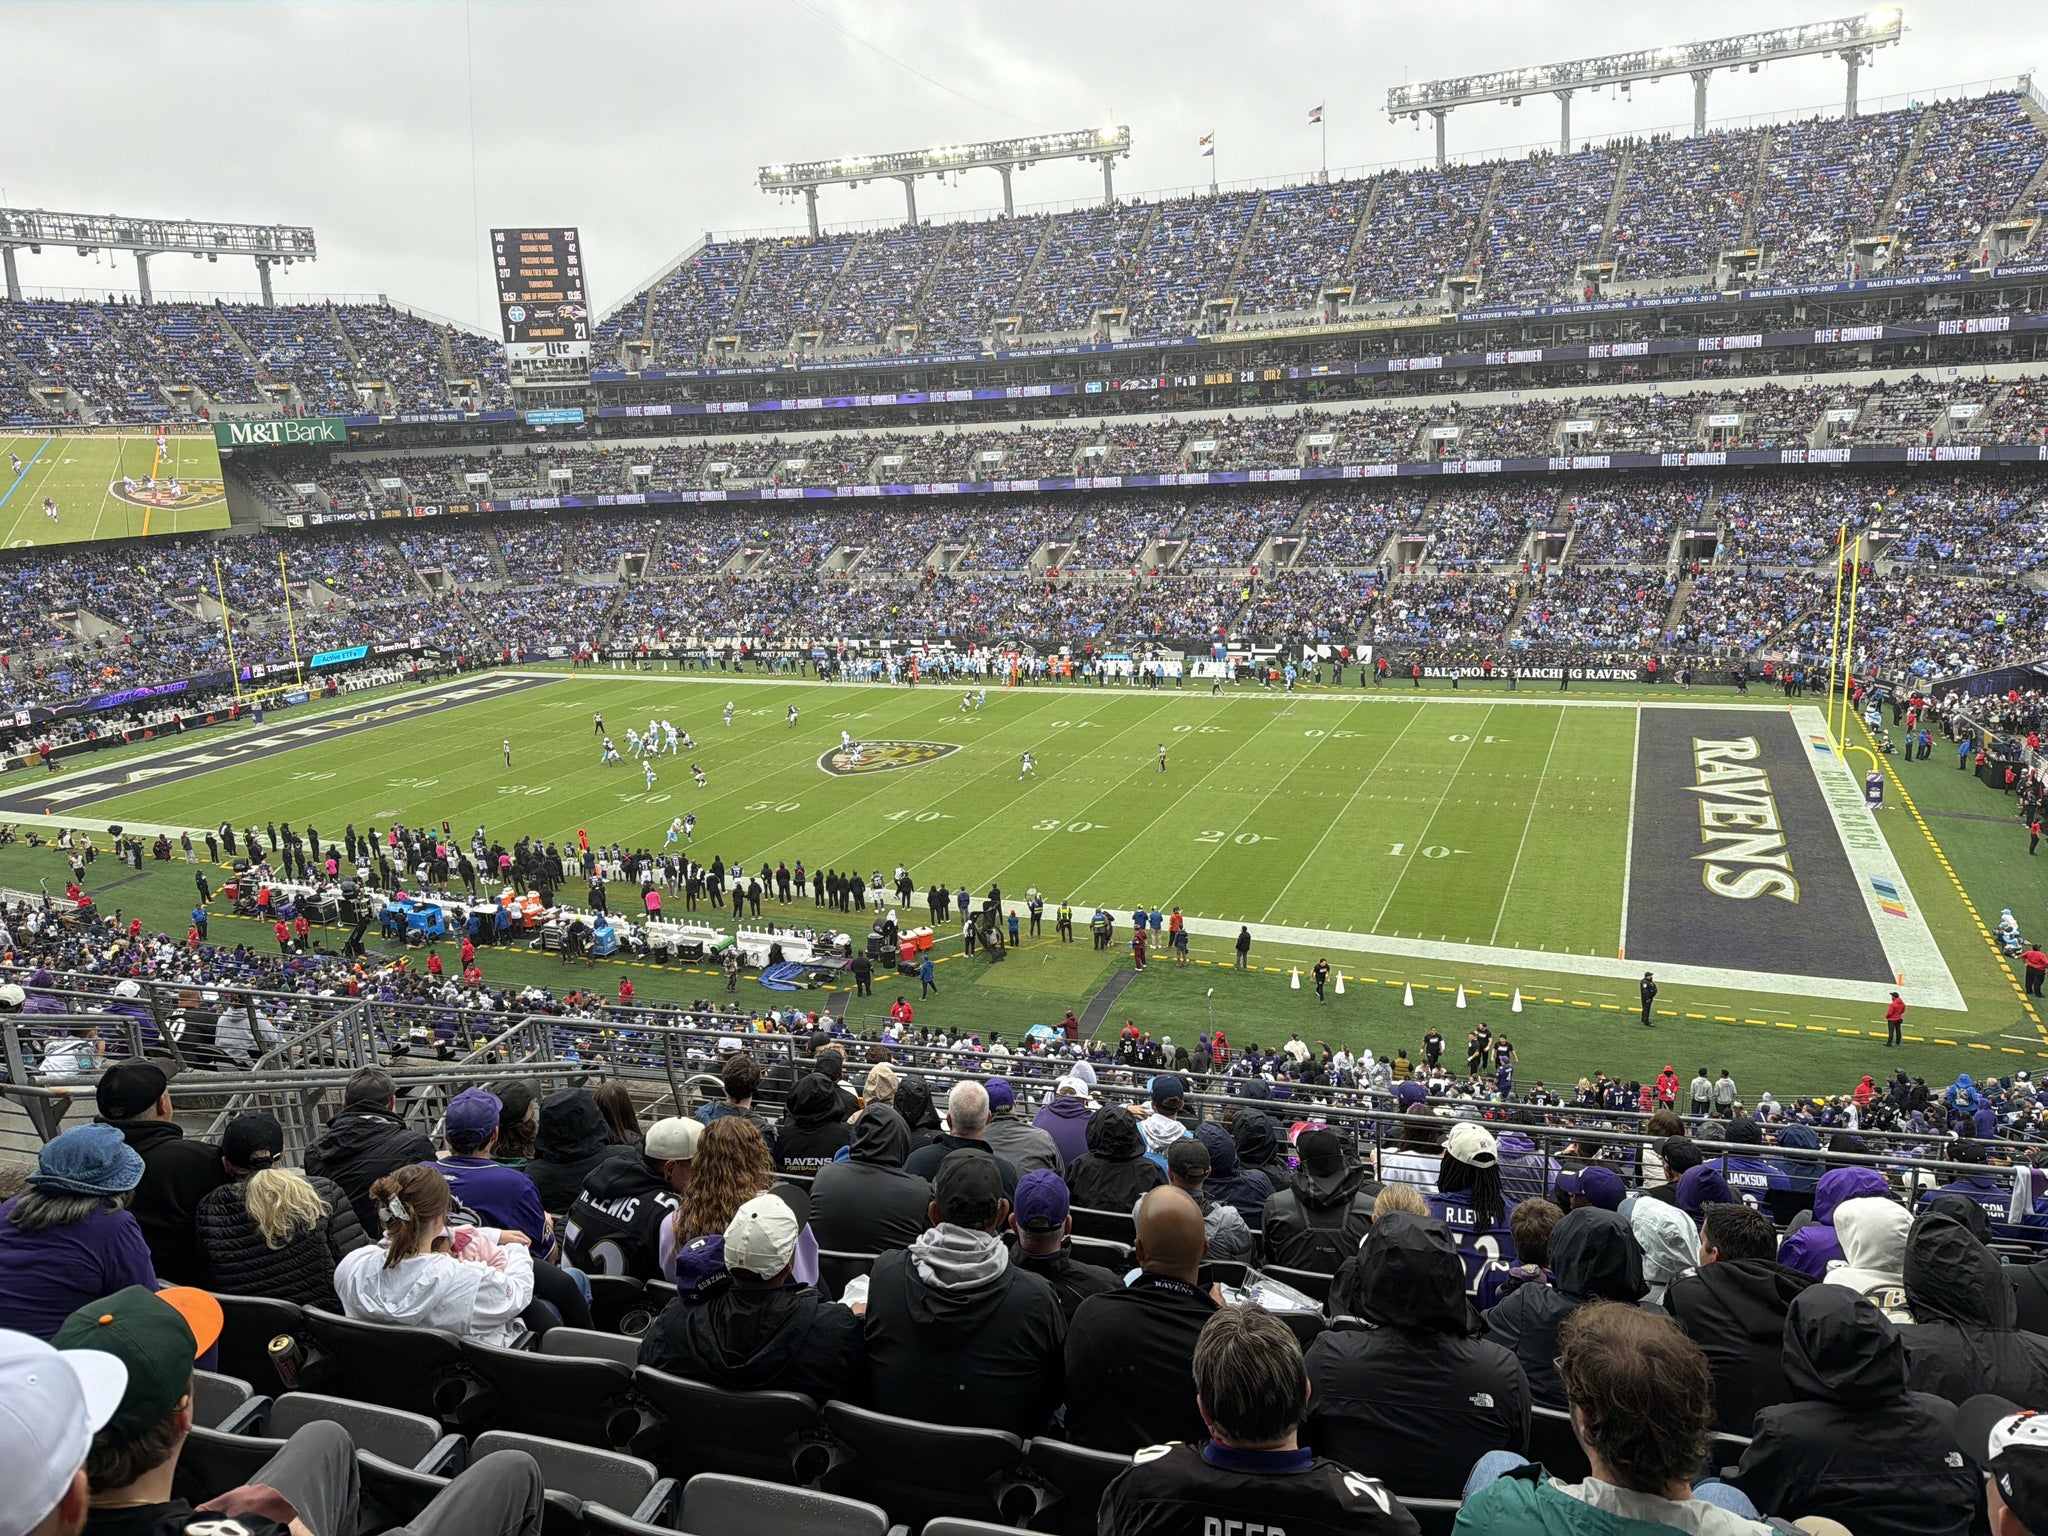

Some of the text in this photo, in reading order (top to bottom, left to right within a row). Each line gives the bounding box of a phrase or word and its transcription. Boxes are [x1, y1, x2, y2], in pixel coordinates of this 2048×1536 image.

[563, 231, 575, 241] 227
[496, 244, 504, 254] 47
[568, 243, 577, 253] 42
[1997, 267, 2017, 275] RING
[1866, 273, 1962, 288] HALOTI NGATA 2006-2014
[1750, 284, 1838, 298] BRIAN BILLICK 1999-2007
[1643, 294, 1717, 307] TODD HEAP 2001-2010
[1462, 309, 1536, 321] MATT STOVER 1996-2008
[1552, 302, 1628, 315] JAMAL LEWIS 2000-2006
[508, 324, 516, 341] 7
[573, 322, 587, 340] 21
[1938, 317, 2011, 335] RISE CONQUER
[1220, 333, 1249, 342] JONATHAN
[1814, 326, 1883, 343] RISE CONQUER
[544, 342, 570, 357] Lite
[1698, 334, 1763, 351] RISE CONQUER
[1588, 342, 1649, 358] RISE CONQUER
[1388, 357, 1443, 371] RISE CONQUER
[1485, 350, 1543, 365] RISE CONQUER
[1189, 375, 1197, 387] 10
[1204, 374, 1216, 385] BALL
[1240, 371, 1255, 383] 2:18
[1276, 368, 1281, 380] 2
[1150, 378, 1158, 389] 21
[228, 420, 336, 444] M&T Bank
[1661, 452, 1727, 466] RISE CONQUER
[1781, 449, 1851, 464] RISE CONQUER
[1907, 446, 1981, 461] RISE CONQUER
[1442, 460, 1502, 474] RISE CONQUER
[1549, 456, 1611, 470] RISE CONQUER
[1248, 469, 1301, 481] RISE CONQUER
[1342, 464, 1398, 478] RISE CONQUER
[323, 512, 356, 522] BETMGM
[321, 654, 342, 663] Active
[1586, 668, 1637, 680] RAVENS
[345, 673, 403, 691] ARYLAND
[20, 677, 534, 803] BALTIMORE
[497, 784, 552, 796] 30
[744, 800, 801, 813] 50
[1820, 770, 1882, 851] CRUCIAL CATCH
[884, 809, 940, 823] 40
[1680, 736, 1800, 905] RAVENS
[1031, 818, 1093, 833] 30
[1194, 830, 1261, 845] 20
[1384, 842, 1451, 859] 10
[784, 1158, 833, 1166] RAVENS
[1727, 1172, 1768, 1187] JACKSON
[1153, 1280, 1194, 1296] RAVENS
